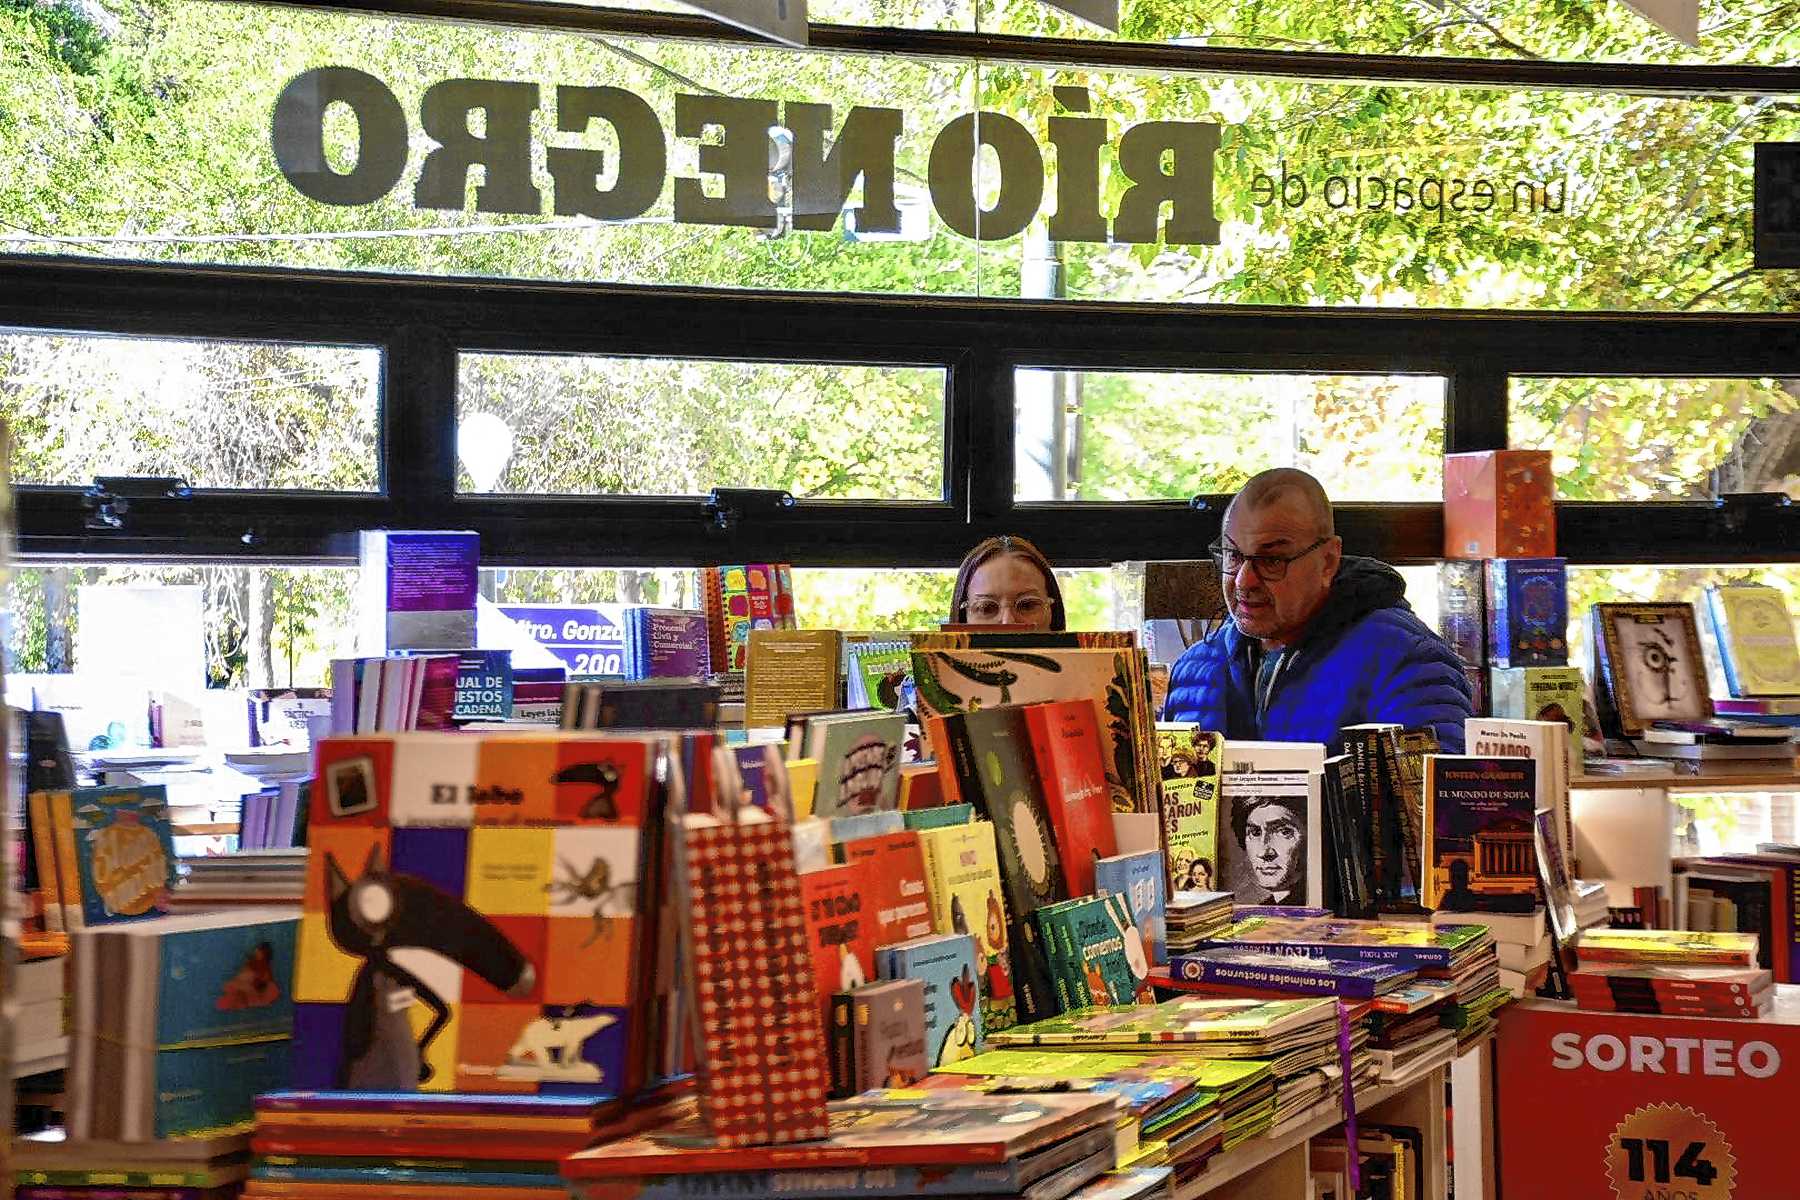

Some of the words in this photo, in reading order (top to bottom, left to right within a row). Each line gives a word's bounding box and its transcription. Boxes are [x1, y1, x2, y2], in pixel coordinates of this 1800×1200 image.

[574, 653, 620, 675] 200
[456, 677, 482, 688] UAL
[485, 677, 502, 688] DE
[456, 704, 503, 714] CADENA
[520, 709, 545, 719] Leyes
[1167, 801, 1202, 819] ARON
[1215, 967, 1269, 983] nocturnos
[1270, 973, 1314, 989] animales
[1314, 977, 1336, 990] Los
[1551, 1032, 1781, 1078] SORTEO
[1620, 1138, 1718, 1186] 114
